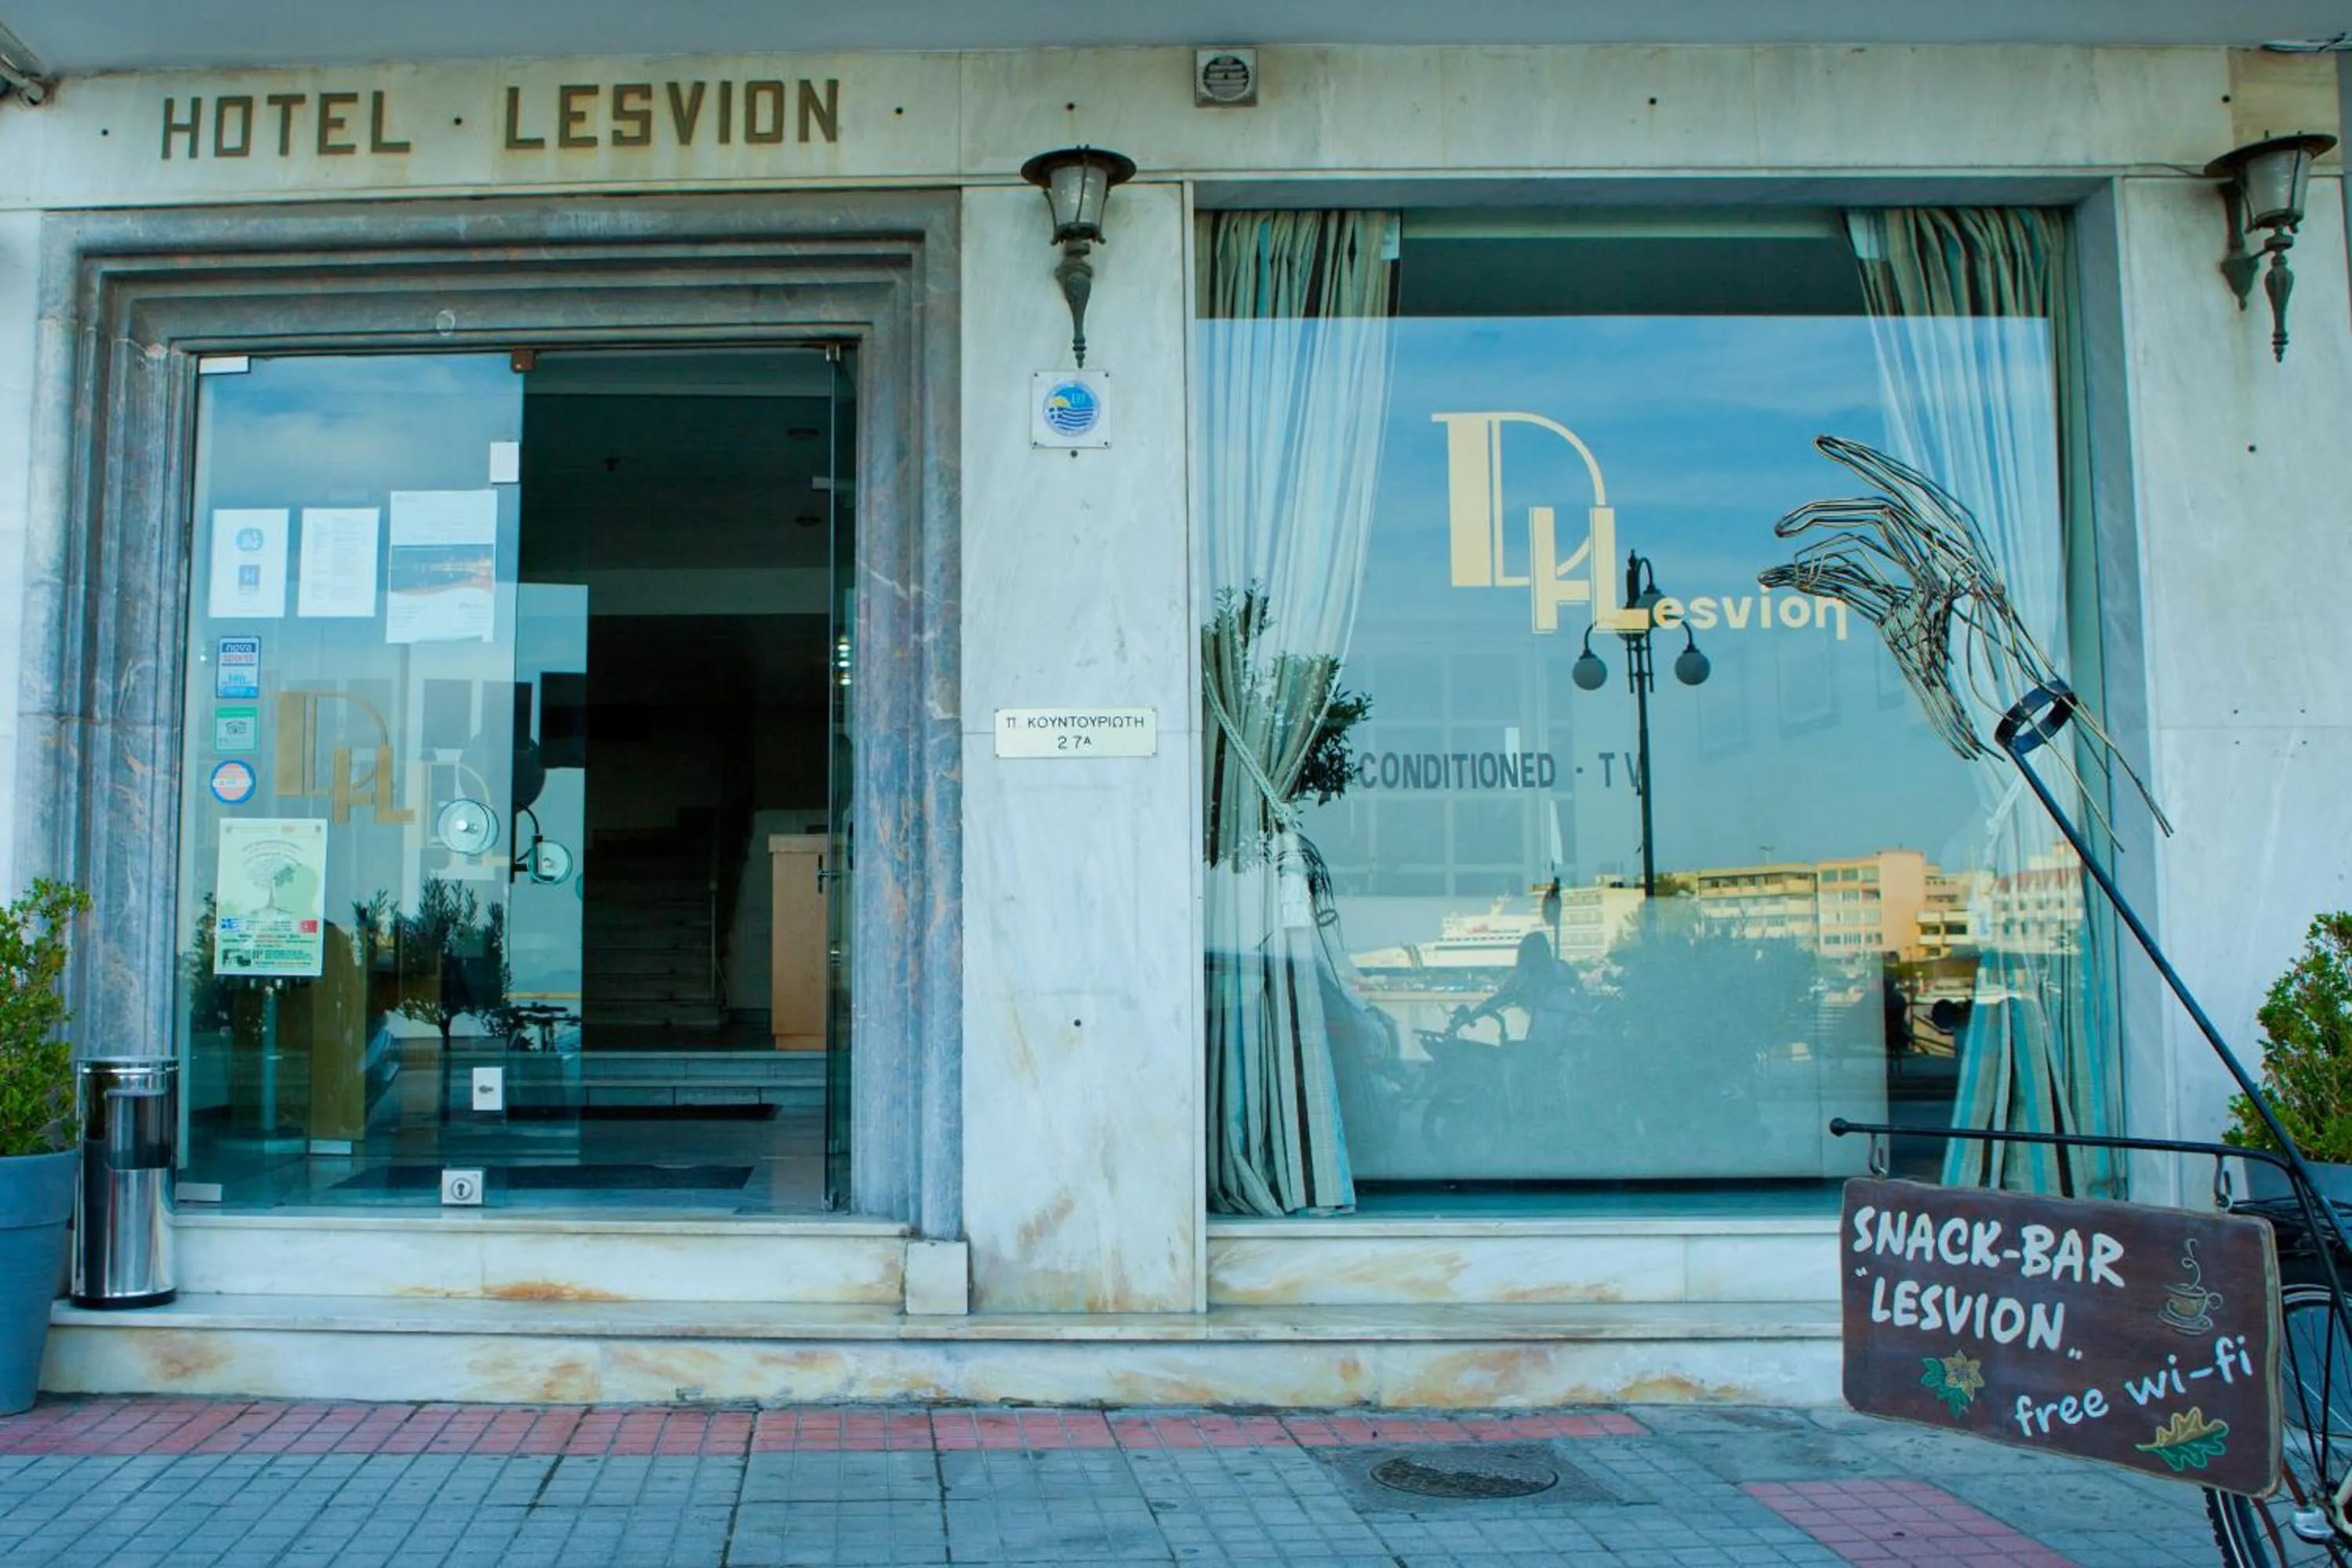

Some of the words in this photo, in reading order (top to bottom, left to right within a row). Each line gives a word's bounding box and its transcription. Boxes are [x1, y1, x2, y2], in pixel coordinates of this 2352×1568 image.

[162, 90, 411, 160] HOTEL
[505, 78, 839, 150] LESVION
[1359, 752, 1556, 790] CONDITIONED
[1853, 1205, 2125, 1287] SNACK-BAR
[2014, 1388, 2110, 1437] free
[2125, 1334, 2254, 1406] wi-fi
